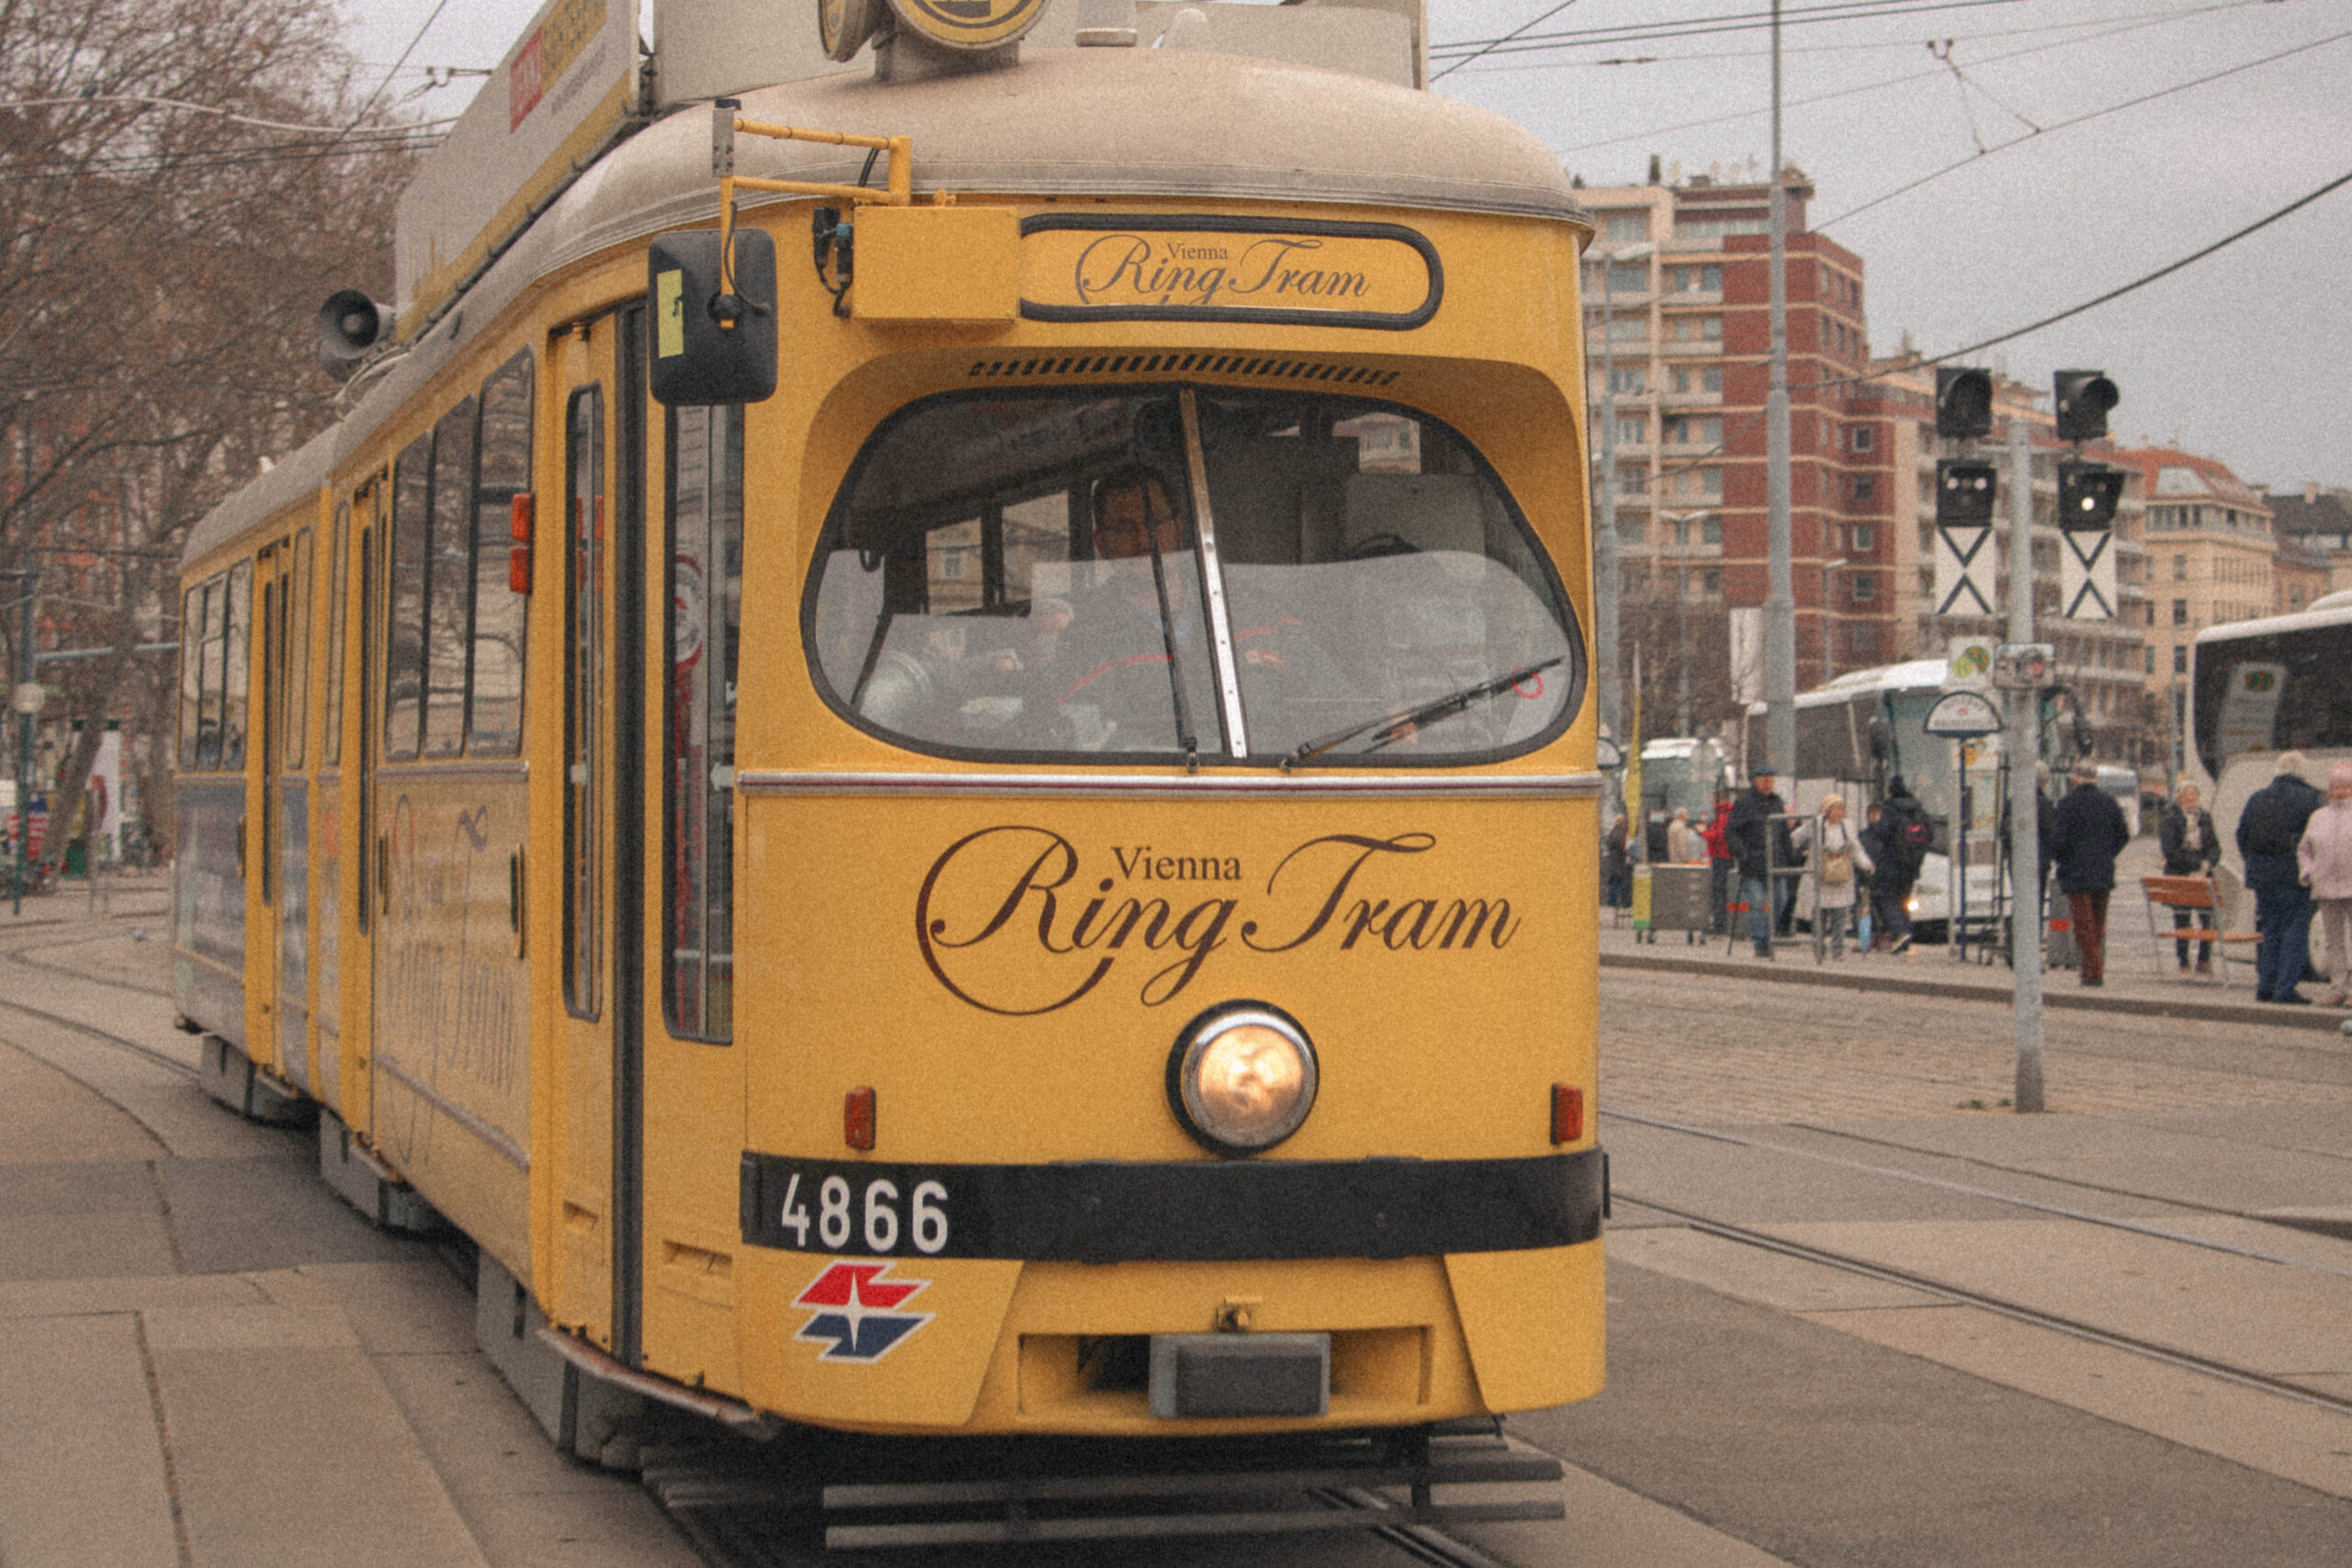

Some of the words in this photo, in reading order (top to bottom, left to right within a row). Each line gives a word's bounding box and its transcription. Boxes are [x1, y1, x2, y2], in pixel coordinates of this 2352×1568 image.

[1075, 233, 1229, 305] Ring
[1229, 238, 1371, 298] Tram
[1166, 242, 1228, 261] Vienna
[1110, 846, 1242, 881] Vienna
[915, 825, 1238, 1016] Ring
[1240, 831, 1521, 953] Tram
[782, 1173, 948, 1254] 4866
